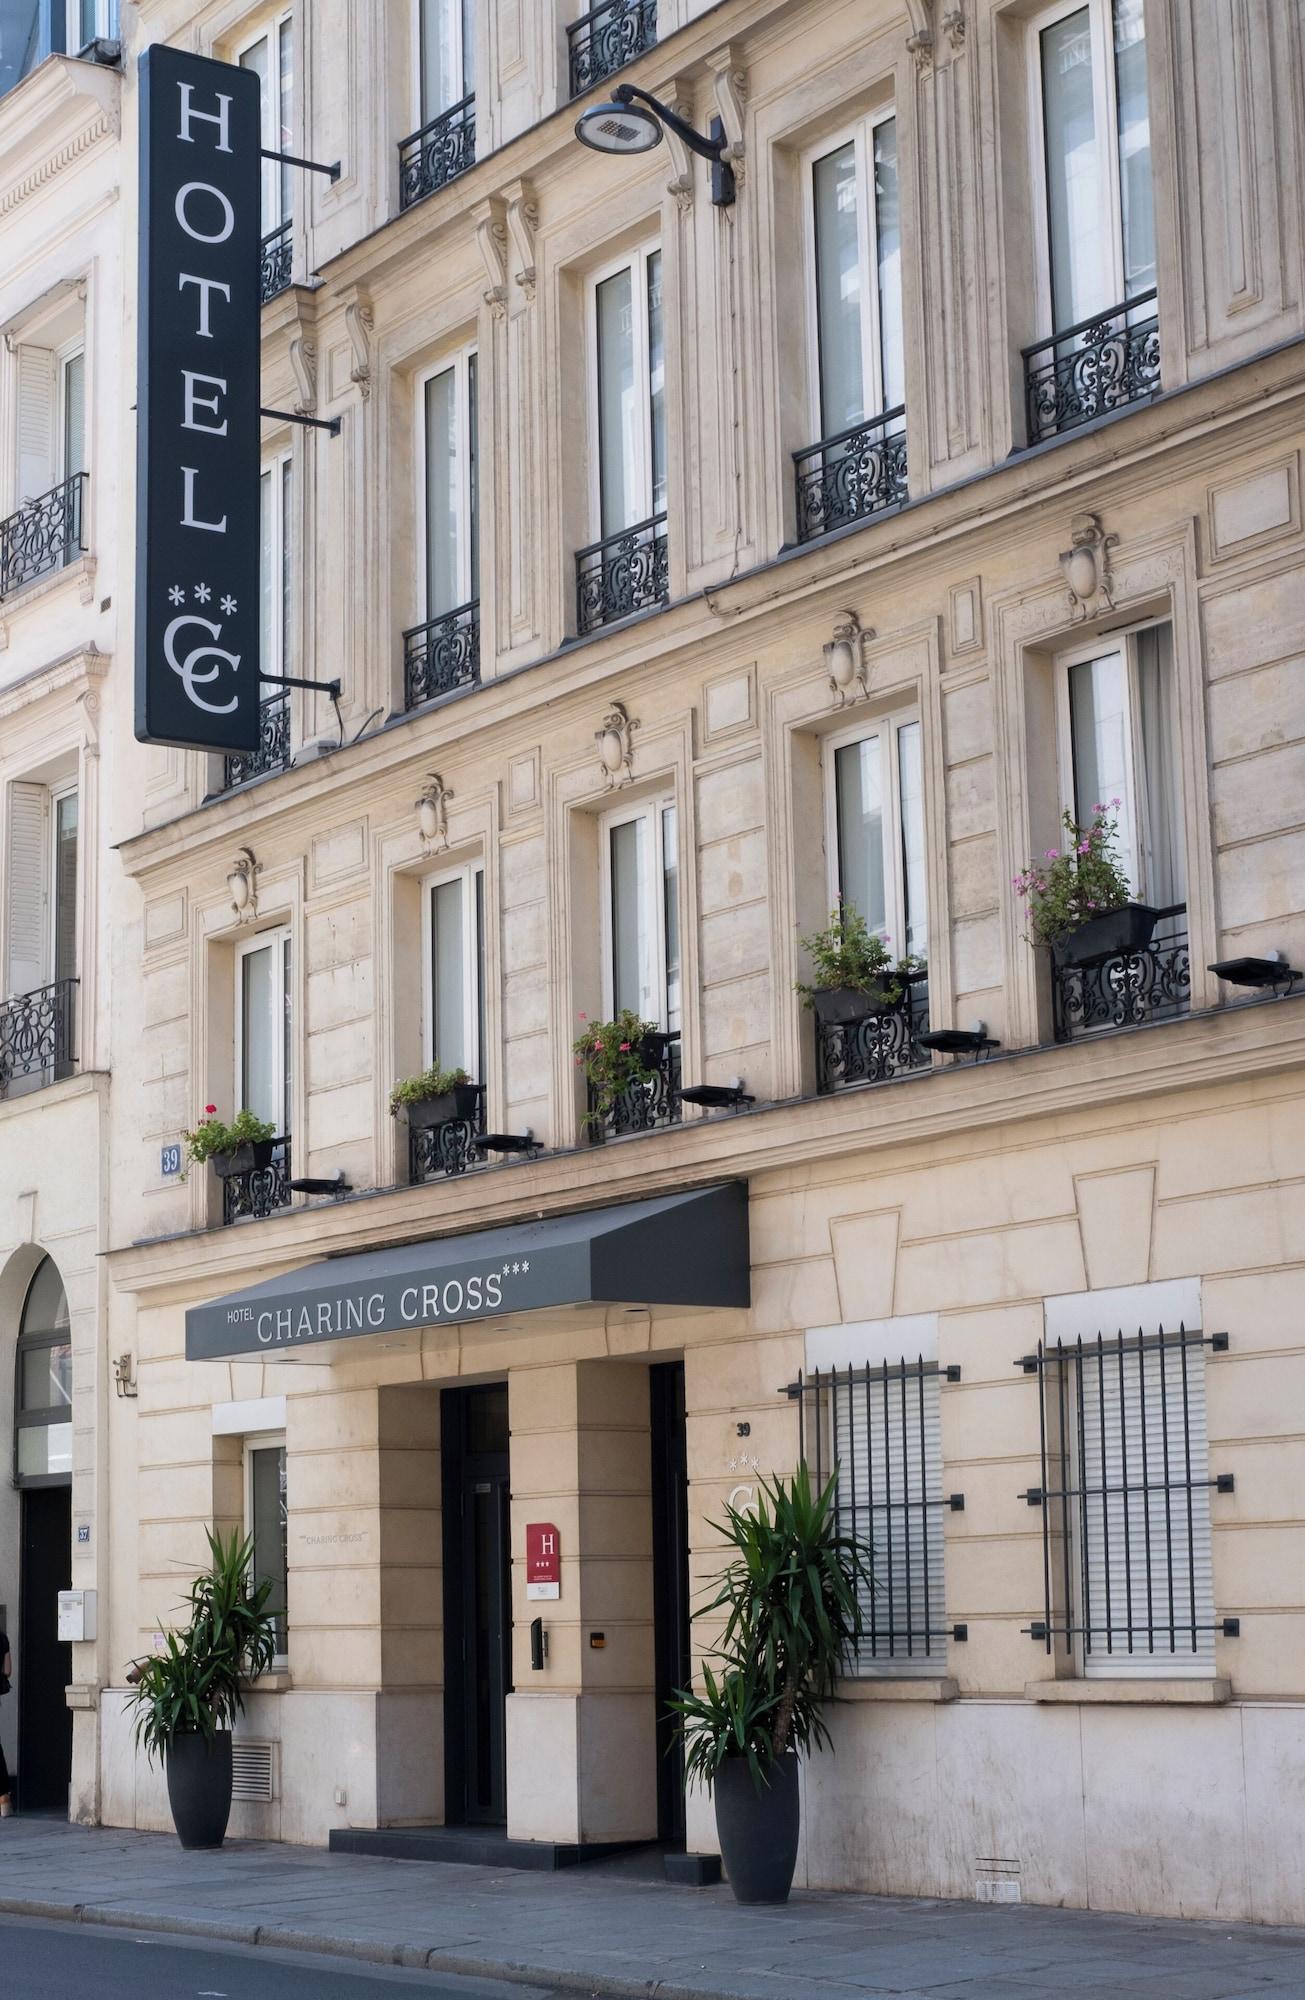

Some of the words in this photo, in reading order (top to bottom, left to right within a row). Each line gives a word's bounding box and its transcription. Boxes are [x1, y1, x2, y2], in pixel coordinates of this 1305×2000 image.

[174, 80, 236, 533] HOTEL
[163, 1149, 178, 1172] 39
[227, 1307, 254, 1324] HOTEL
[257, 1293, 386, 1343] CHARING
[400, 1273, 503, 1321] CROSS
[736, 1422, 751, 1437] 39
[541, 1533, 555, 1555] H
